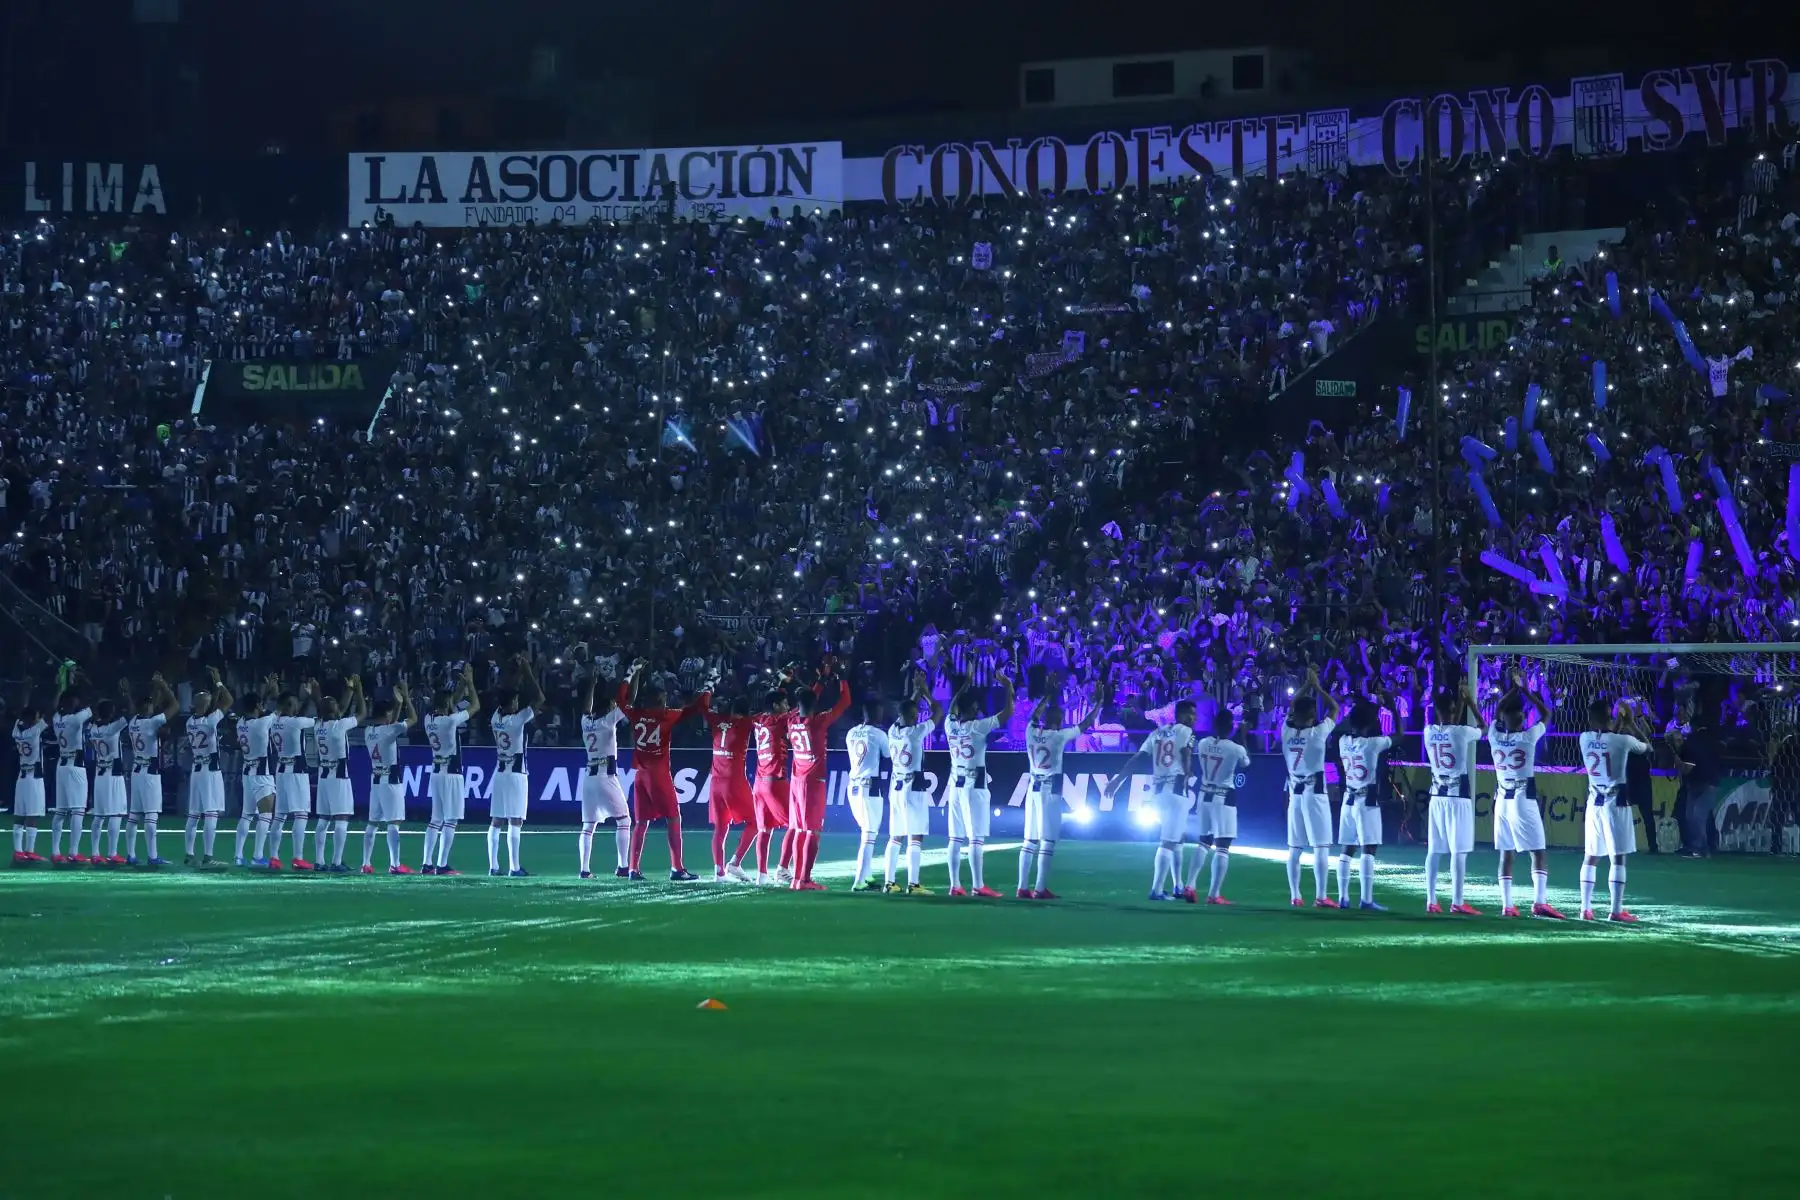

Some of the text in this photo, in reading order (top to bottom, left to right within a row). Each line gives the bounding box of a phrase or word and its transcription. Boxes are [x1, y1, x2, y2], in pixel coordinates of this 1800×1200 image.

[1382, 84, 1554, 177] CONO
[881, 114, 1300, 207] CONO OESTE
[24, 161, 167, 214] LIMA
[364, 146, 817, 204] LA ASOCIACIÓN
[242, 364, 365, 390] SALIDA
[1316, 380, 1344, 395] SALIDA
[634, 722, 661, 747] 24
[790, 731, 811, 752] 31
[1155, 739, 1174, 767] 18
[1289, 747, 1304, 771] 7
[1430, 743, 1456, 769] 15
[1494, 749, 1526, 770] 23
[1587, 751, 1611, 778] 21
[1200, 753, 1224, 781] 17
